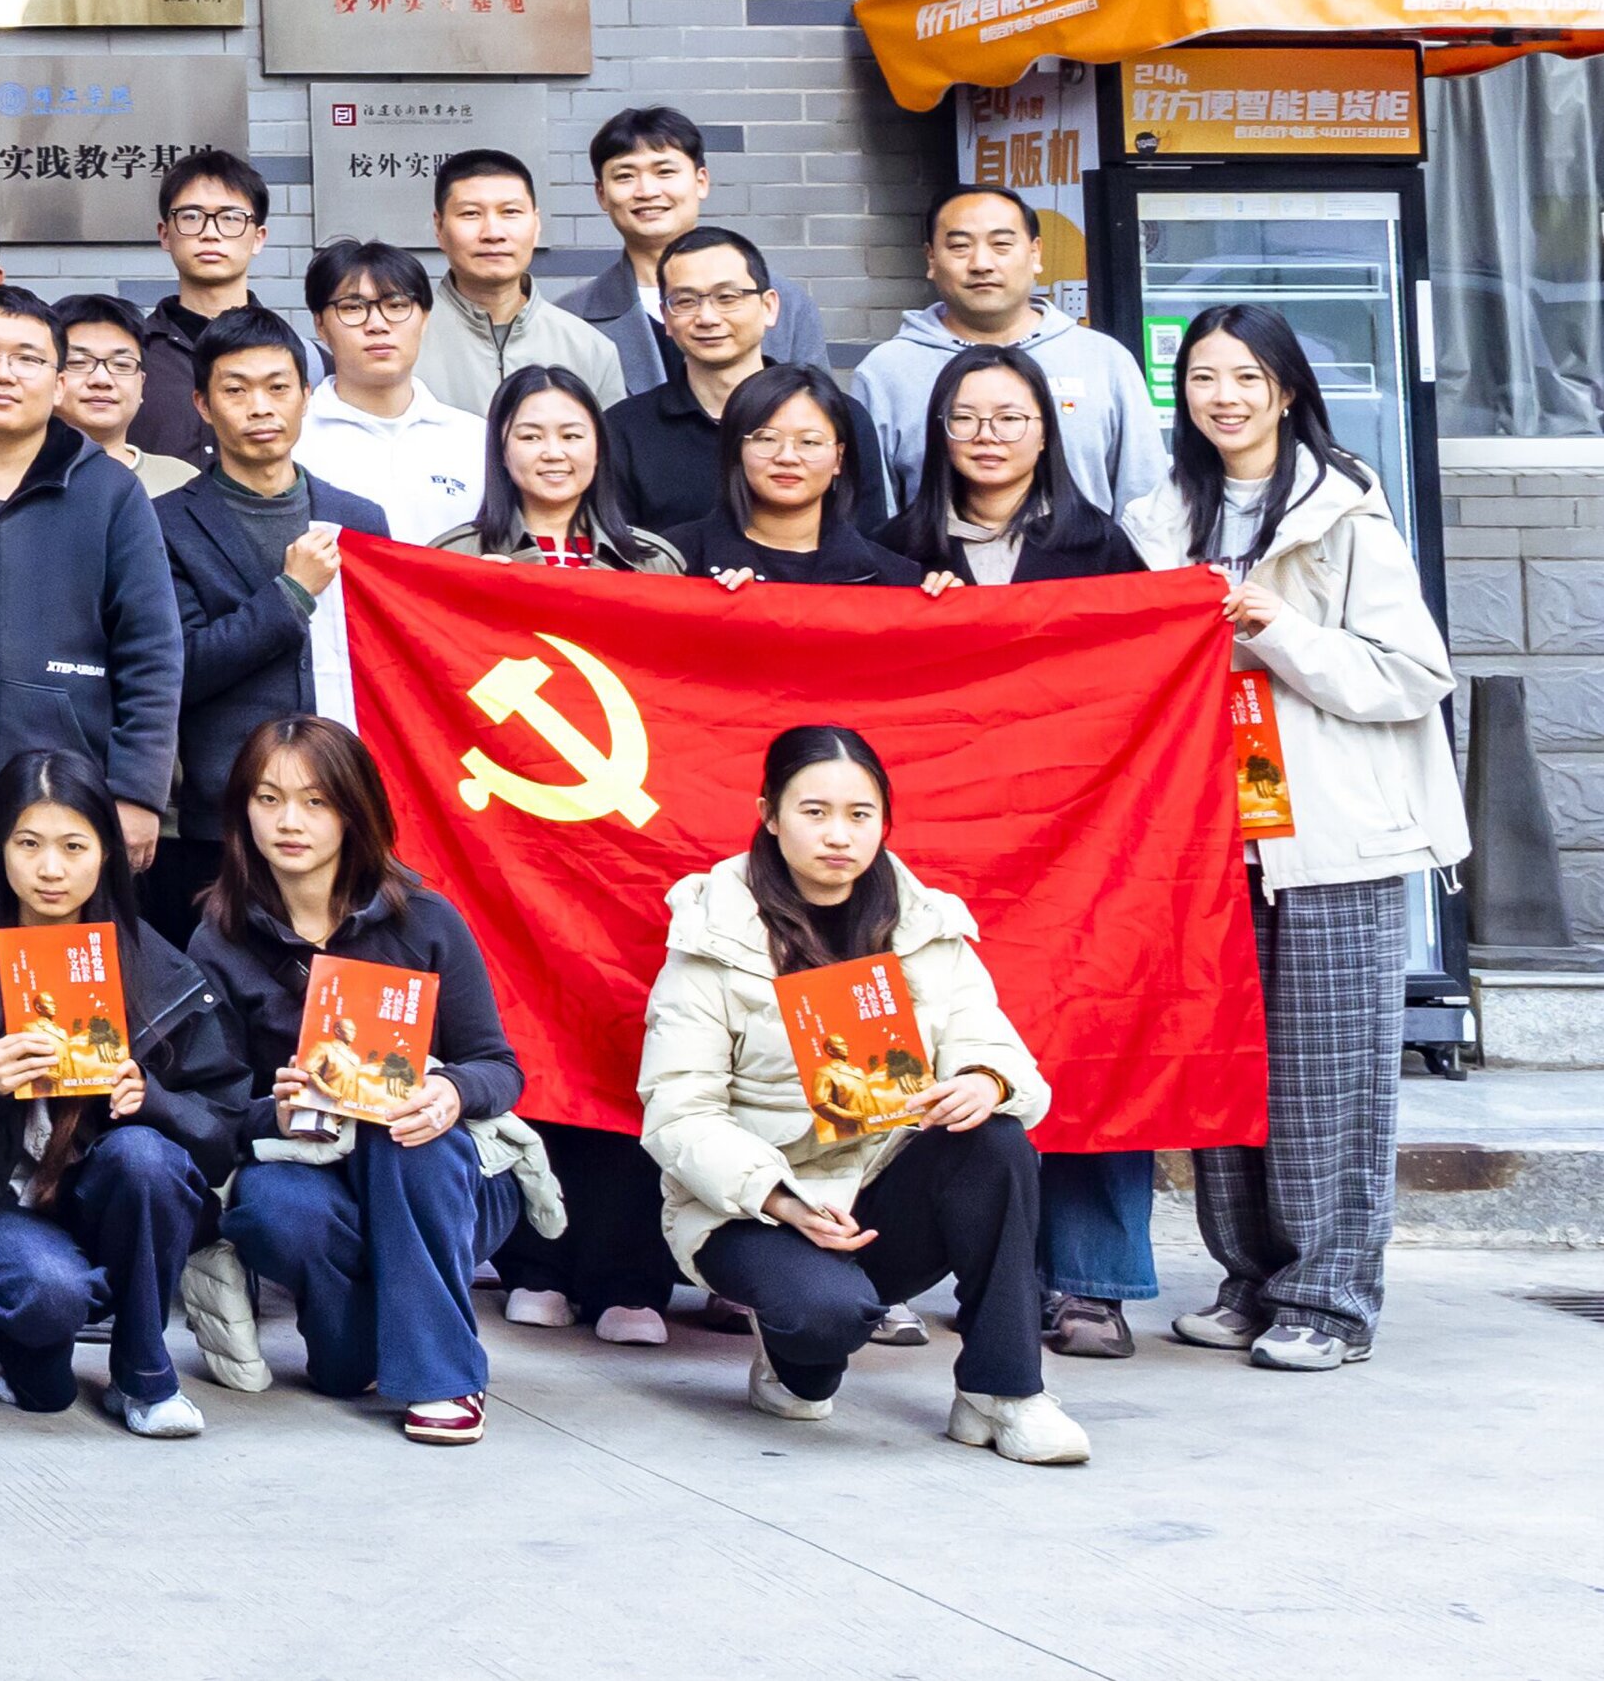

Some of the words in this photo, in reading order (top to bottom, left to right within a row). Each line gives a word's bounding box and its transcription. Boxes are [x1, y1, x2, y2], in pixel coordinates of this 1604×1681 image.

[1134, 64, 1188, 85] 24h
[1132, 89, 1410, 121] 好方便智能售货柜
[975, 129, 1080, 188] 自贩机
